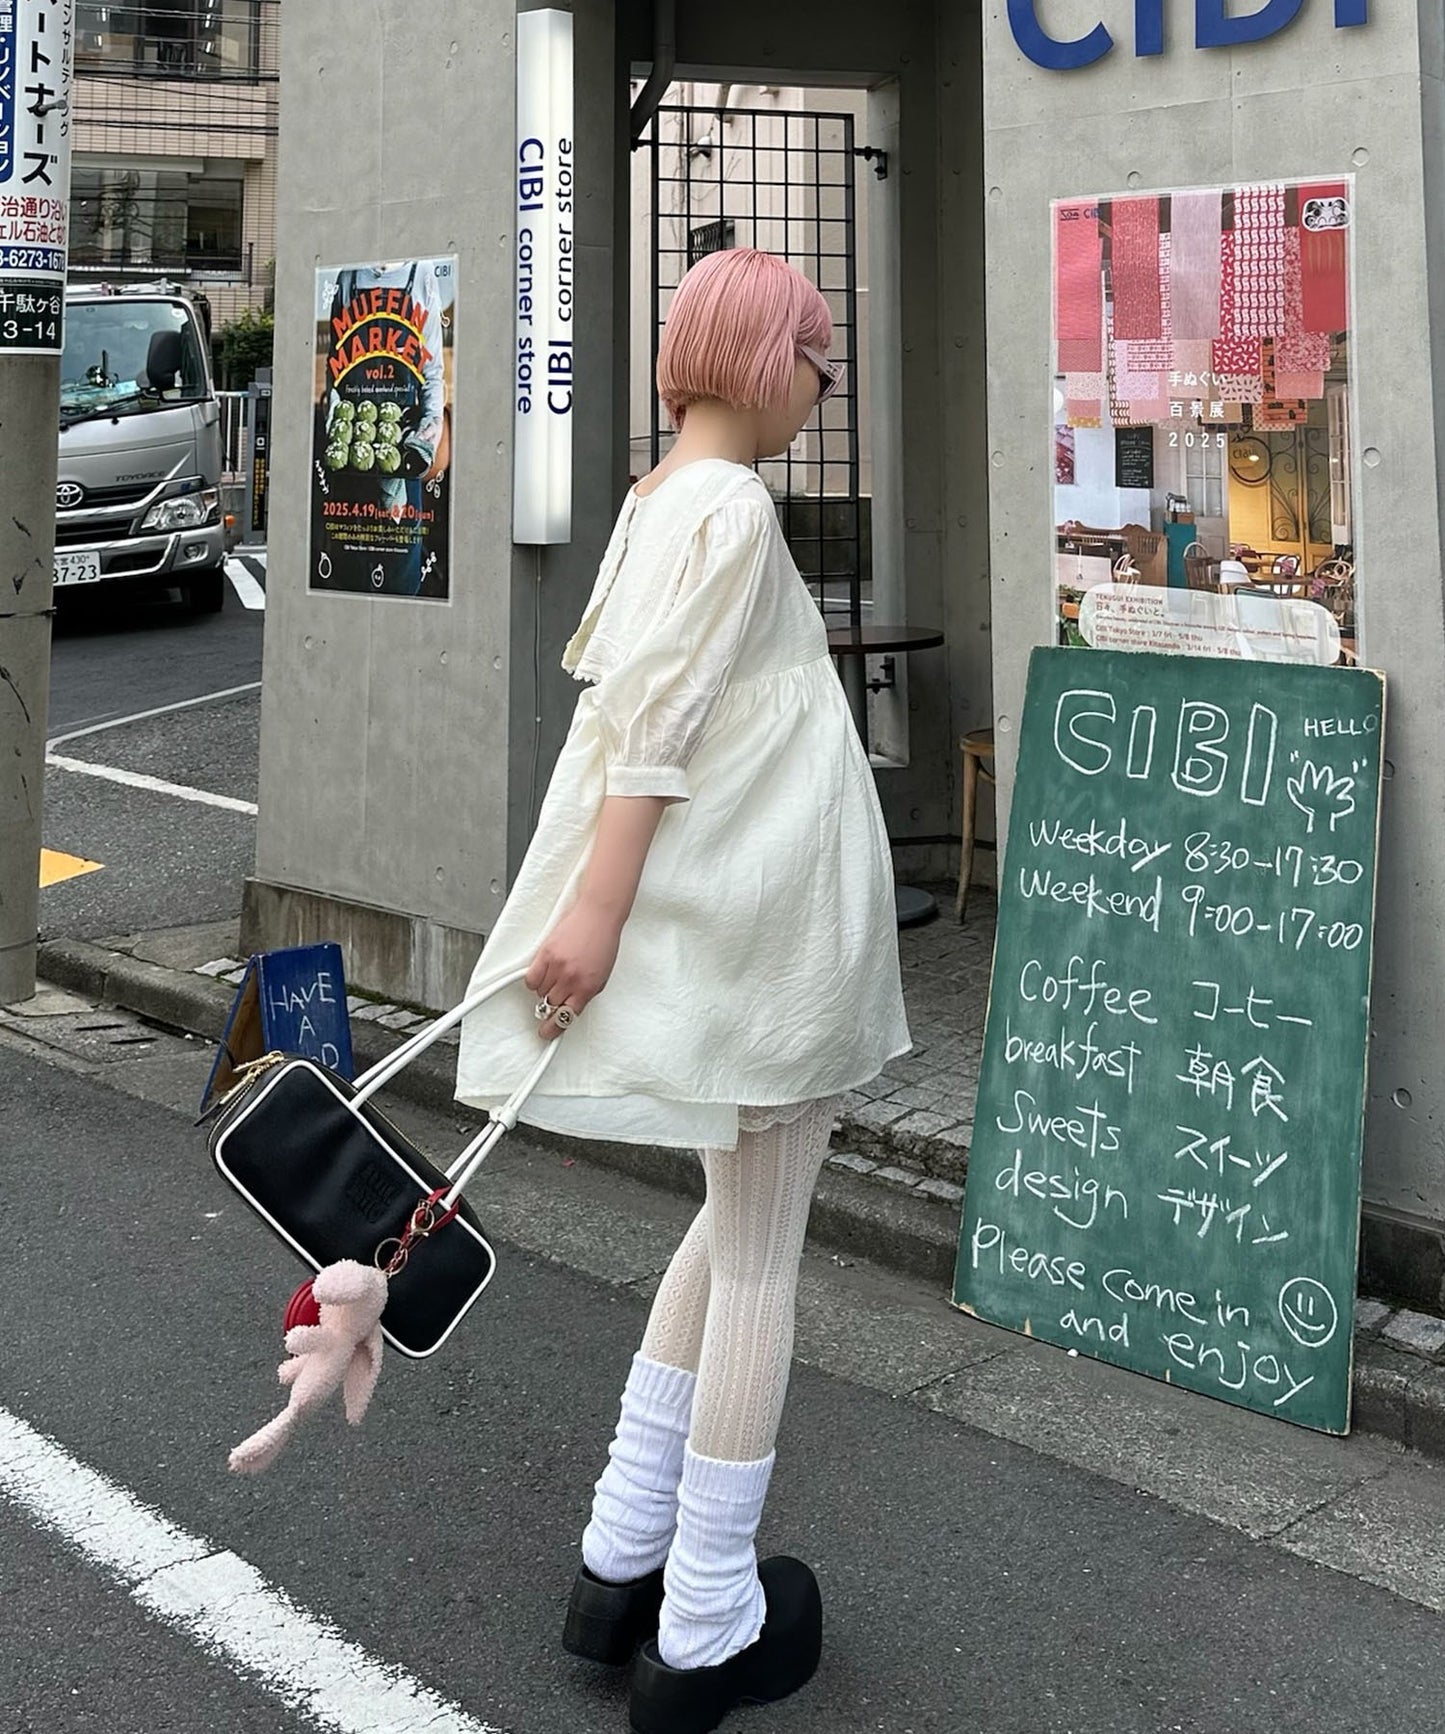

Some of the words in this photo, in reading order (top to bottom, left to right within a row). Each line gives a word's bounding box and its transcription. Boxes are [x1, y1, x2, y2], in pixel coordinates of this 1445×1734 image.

[21, 0, 58, 186] ートナーズ
[519, 138, 544, 211] CIBI
[555, 138, 572, 213] store
[434, 264, 452, 277] CIBI
[519, 228, 533, 326] corner
[558, 223, 572, 322] corner
[3, 320, 56, 340] 3-14
[332, 287, 429, 340] MUFFIN
[329, 327, 433, 380] MARKET
[365, 364, 395, 380] vol.2
[518, 337, 535, 414] store
[548, 340, 573, 415] CIBI
[1168, 371, 1226, 387] 手ぬぐい
[1168, 401, 1225, 418] 百景展
[1168, 432, 1225, 448] 2025
[1054, 688, 1278, 806] CIBI
[1304, 713, 1379, 738] HELLO
[1029, 818, 1172, 872] Weekday
[1019, 867, 1163, 933] Weekend
[268, 972, 336, 1021] HAVE
[1020, 955, 1159, 1024] Coffee
[1192, 980, 1313, 1029] コーヒー
[298, 1015, 316, 1045] A
[1003, 1015, 1142, 1094] breakfast
[1176, 1042, 1289, 1123] 朝食
[996, 1089, 1121, 1158] Sweets
[1174, 1125, 1289, 1188] スイーツ
[995, 1148, 1128, 1229] design
[1157, 1188, 1290, 1244] デザイン
[1102, 1268, 1208, 1325] come
[1214, 1289, 1250, 1327] in
[1059, 1308, 1130, 1348] and
[1161, 1332, 1316, 1407] enjoy
